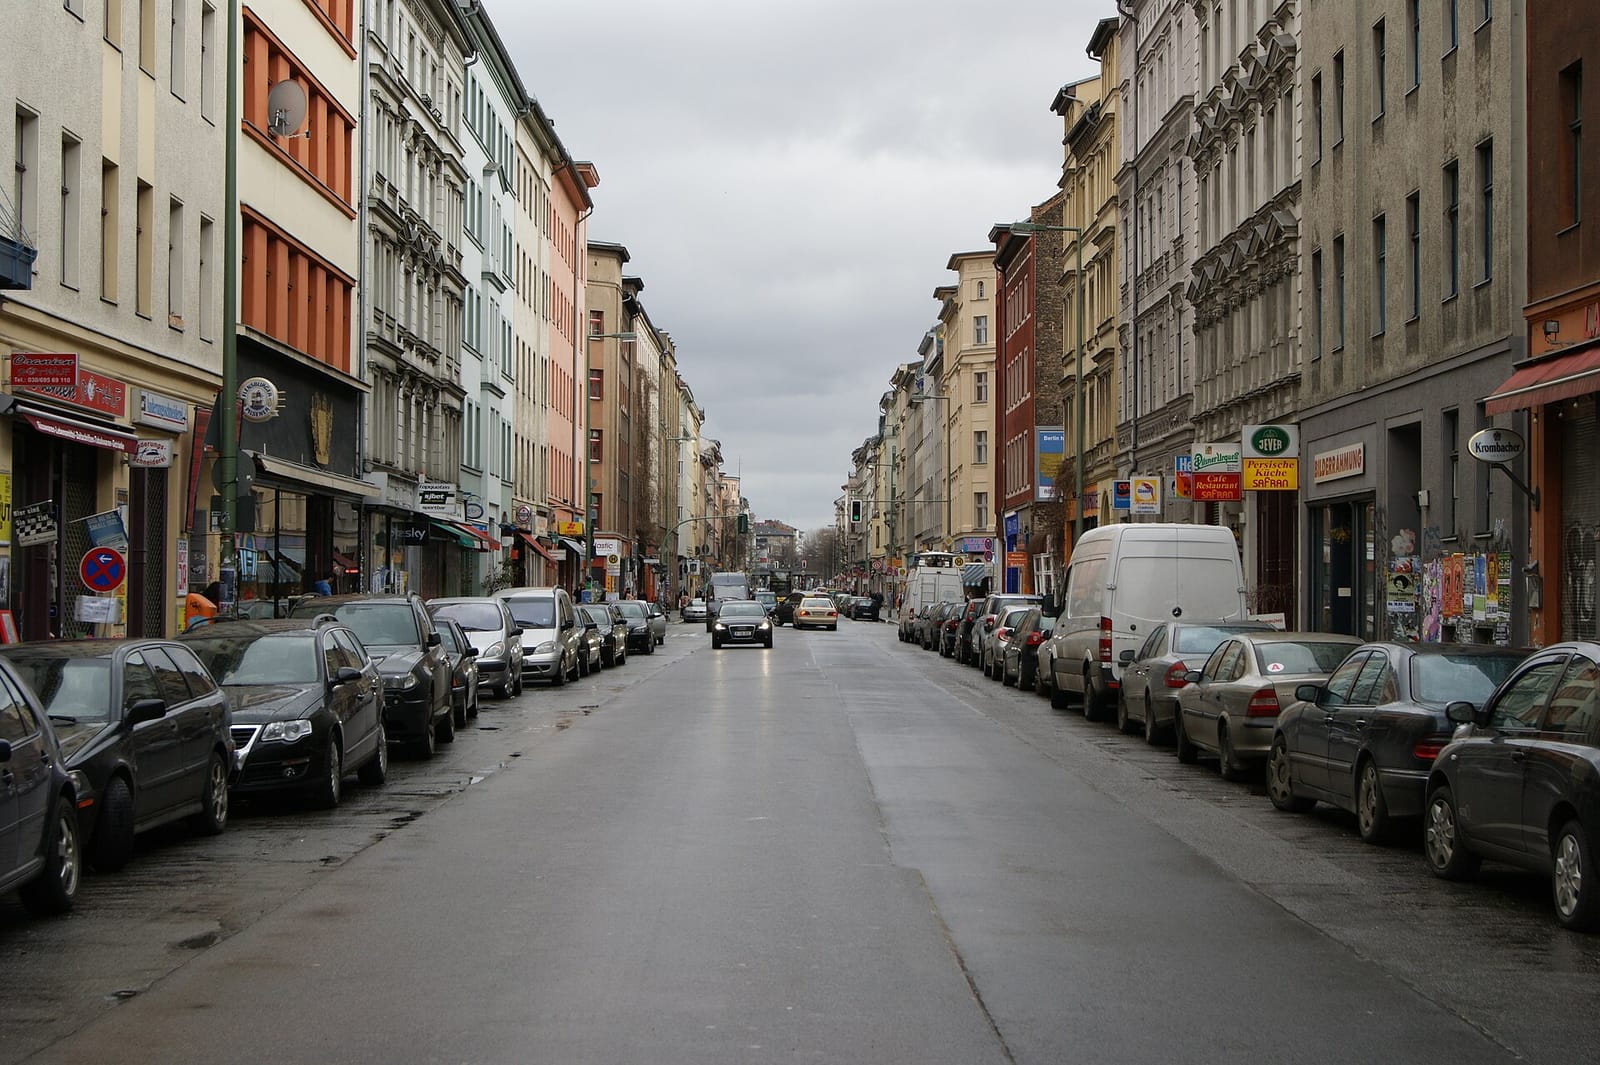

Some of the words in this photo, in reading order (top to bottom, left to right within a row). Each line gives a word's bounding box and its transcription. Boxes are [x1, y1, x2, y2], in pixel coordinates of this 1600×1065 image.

[13, 354, 75, 366] Oranien
[137, 441, 166, 450] nderungs-
[1259, 438, 1282, 451] JEVER
[1475, 442, 1520, 453] Krombacher
[1247, 460, 1294, 469] Persische
[1314, 448, 1362, 478] BILDERRAHMUNG
[1255, 468, 1287, 477] Küche
